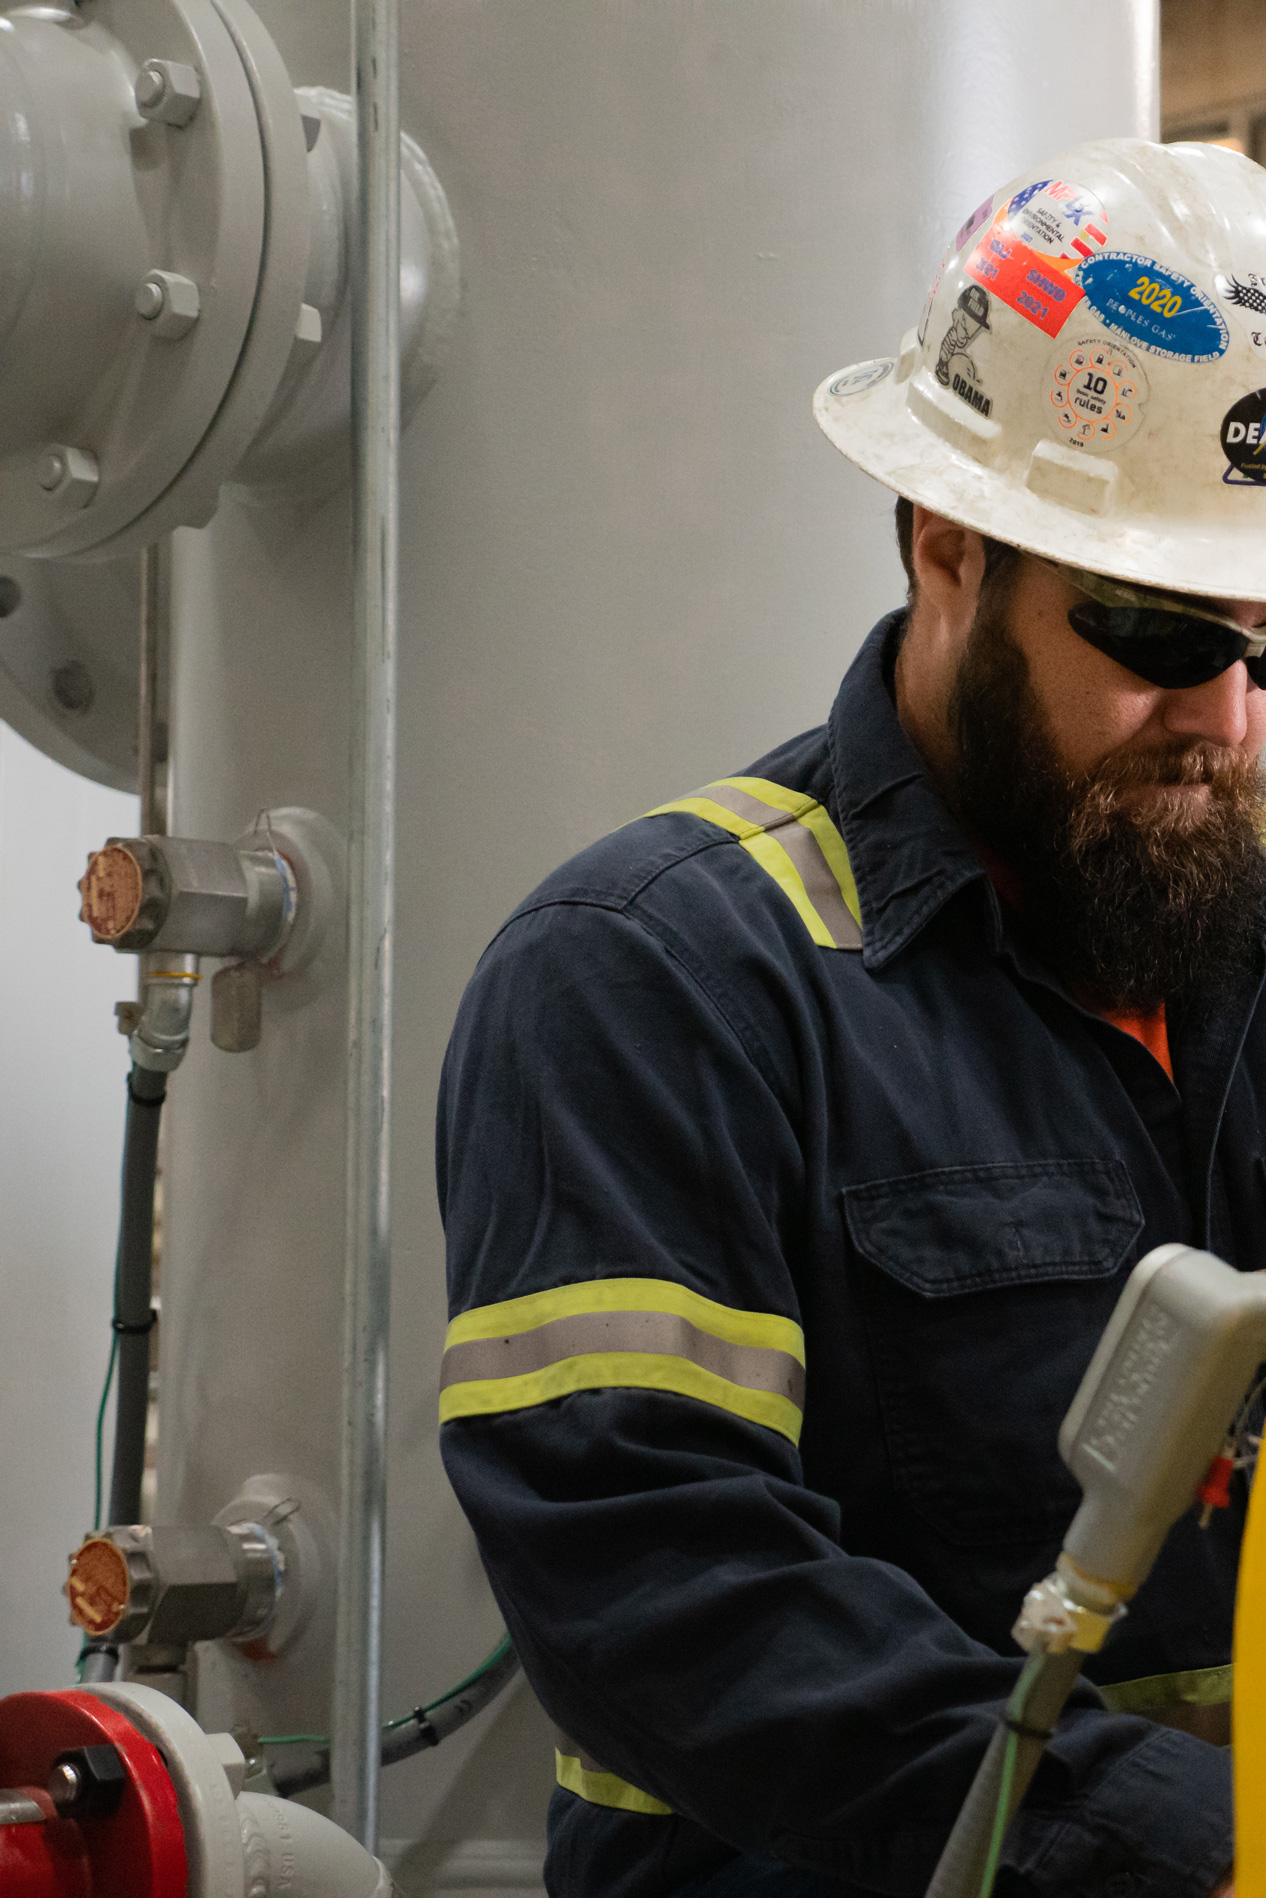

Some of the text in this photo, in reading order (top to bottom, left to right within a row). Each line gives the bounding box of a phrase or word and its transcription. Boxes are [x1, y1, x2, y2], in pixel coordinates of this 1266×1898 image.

[1022, 208, 1065, 243] ENVIRONMENTAL
[1022, 216, 1055, 244] RIENTATION
[1036, 207, 1057, 223] SAFETY
[1026, 269, 1066, 302] SHWD
[1081, 252, 1229, 350] CONTRACTOR SAFETY ORIENTATION
[1128, 276, 1182, 318] 2020
[968, 298, 984, 316] FIELD
[1016, 290, 1049, 320] 2021
[1106, 298, 1174, 340] PEOPLES GAS
[1090, 306, 1105, 323] GAS
[1149, 344, 1192, 363] STORAGE
[1194, 351, 1220, 363] FIELD
[1103, 339, 1136, 368] ORIENTATION
[952, 373, 991, 417] OBAMA
[1083, 372, 1107, 395] 10
[1074, 396, 1103, 415] rules
